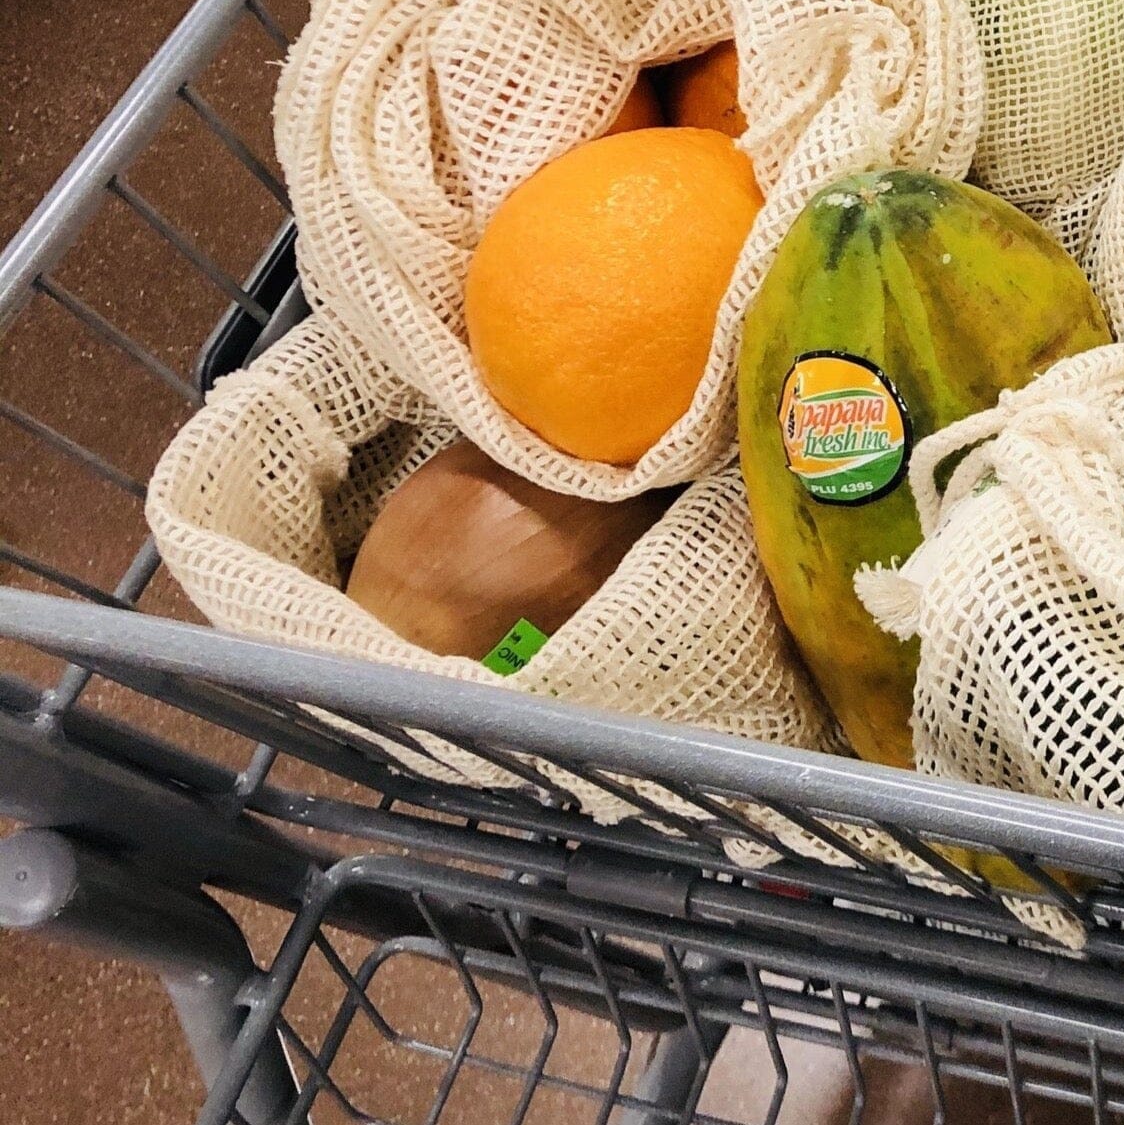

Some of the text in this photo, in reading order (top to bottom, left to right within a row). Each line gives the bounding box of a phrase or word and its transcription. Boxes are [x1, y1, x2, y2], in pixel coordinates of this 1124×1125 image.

[798, 398, 885, 439] papaya
[804, 424, 858, 457] fresh
[811, 481, 874, 494] PLU 4395
